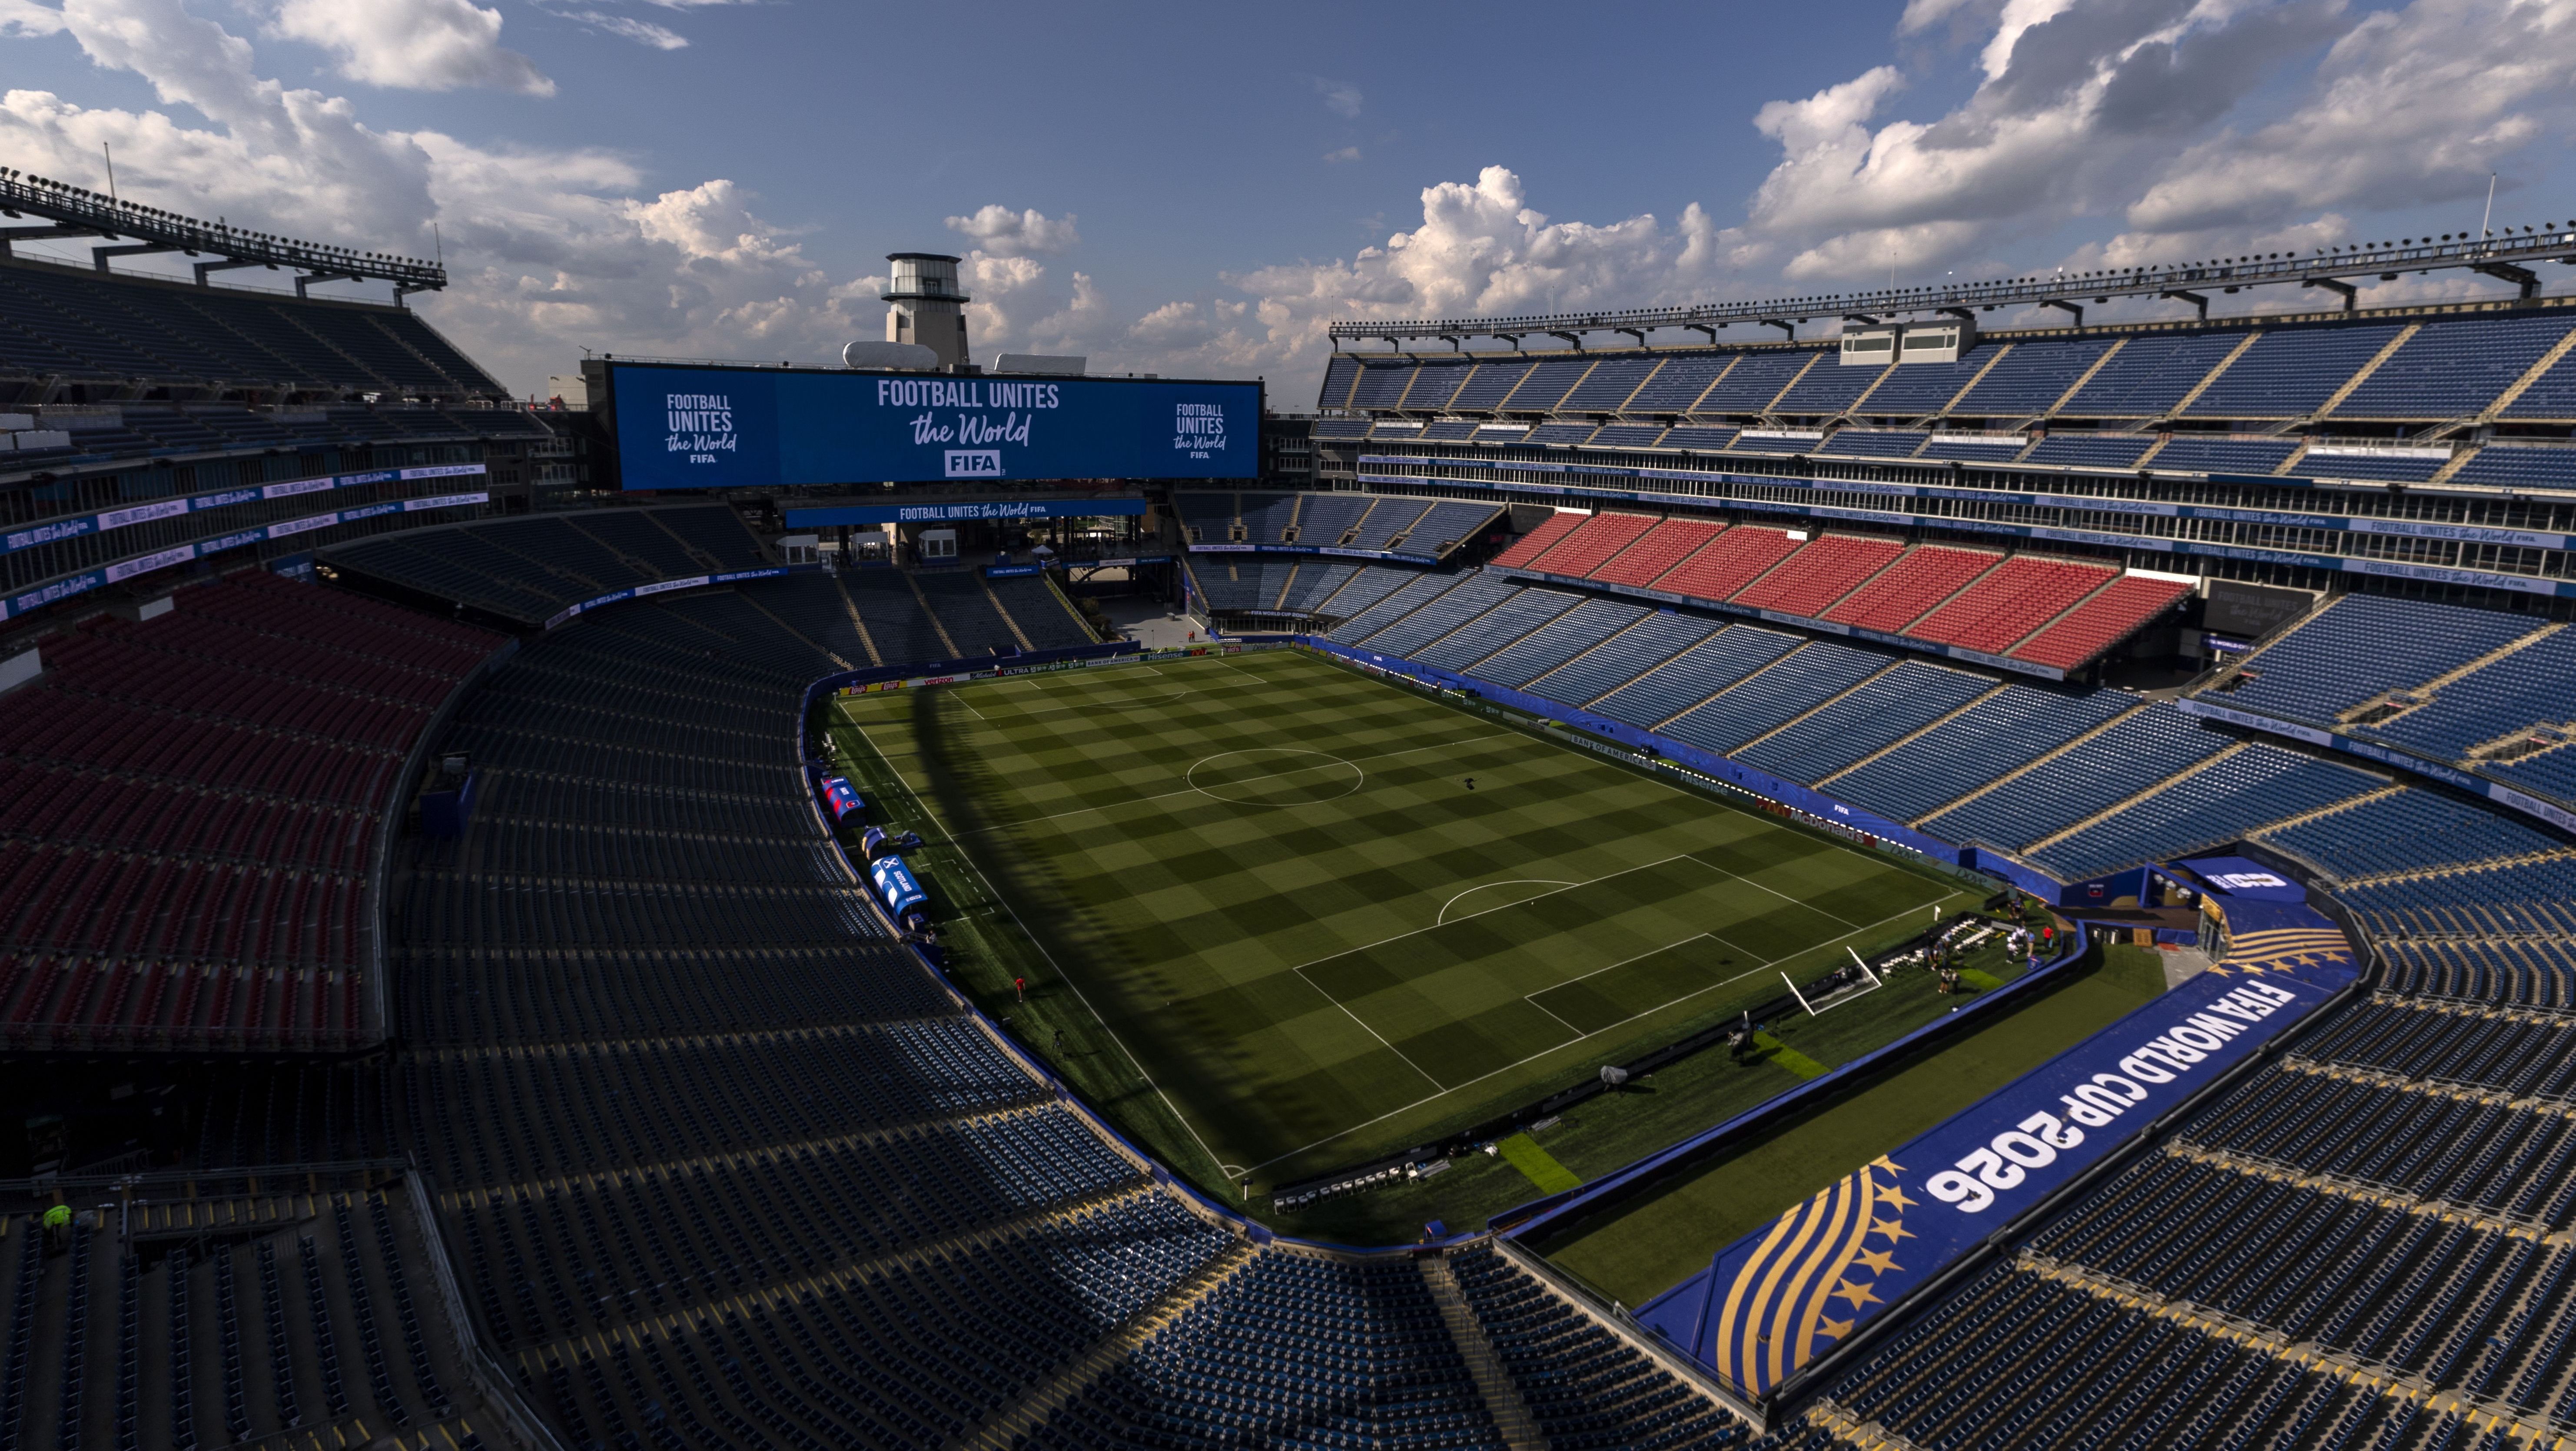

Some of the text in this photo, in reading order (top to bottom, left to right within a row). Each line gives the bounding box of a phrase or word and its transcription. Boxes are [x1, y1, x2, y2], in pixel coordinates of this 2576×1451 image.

[667, 394, 731, 410] FOOTBALL
[878, 380, 1059, 408] FOOTBALL UNITES
[1177, 404, 1223, 416] FOOTBALL
[668, 411, 732, 432] UNITES
[910, 411, 1031, 447] the World
[1177, 417, 1223, 434] UNITES
[665, 433, 737, 452] the World
[1173, 434, 1226, 451] the World
[690, 455, 716, 463] FIFA
[950, 456, 996, 471] FIFA
[1928, 489, 1955, 497] FOOTBALL
[1956, 490, 1975, 499] UNITES
[900, 507, 945, 520] FOOTBALL
[948, 506, 979, 517] UNITES
[981, 504, 998, 517] the
[999, 503, 1029, 517] World
[2194, 508, 2231, 519] FOOTBALL
[2233, 510, 2261, 521] UNITES
[2371, 522, 2417, 534] FOOTBALL
[2420, 525, 2455, 537] UNITES
[2458, 528, 2479, 538] the
[2479, 530, 2515, 543] World
[2364, 563, 2410, 576] FOOTBALL
[2413, 567, 2447, 580] UNITES
[2450, 570, 2470, 582] the
[2472, 573, 2506, 588] World
[1770, 613, 1789, 622] FOOTBALL
[924, 676, 953, 685] verizon
[2193, 703, 2225, 717] FOOTBALL
[2228, 712, 2254, 723] UNITES
[1527, 721, 1544, 731] BOSTON
[1574, 737, 1594, 749] BANK
[1608, 749, 1643, 766] AMERICA
[1680, 772, 1728, 796] Hisense
[1834, 804, 1849, 815] FIFA
[2506, 792, 2541, 814] FOOTBALL
[2544, 805, 2567, 825] UNITES
[1790, 809, 1864, 843] McDonald's
[1890, 845, 1919, 861] Dove
[893, 870, 912, 891] SCOTLAND
[1956, 868, 1987, 885] Dove
[1925, 979, 2296, 1213] FIFA WORLD CUP 2026
